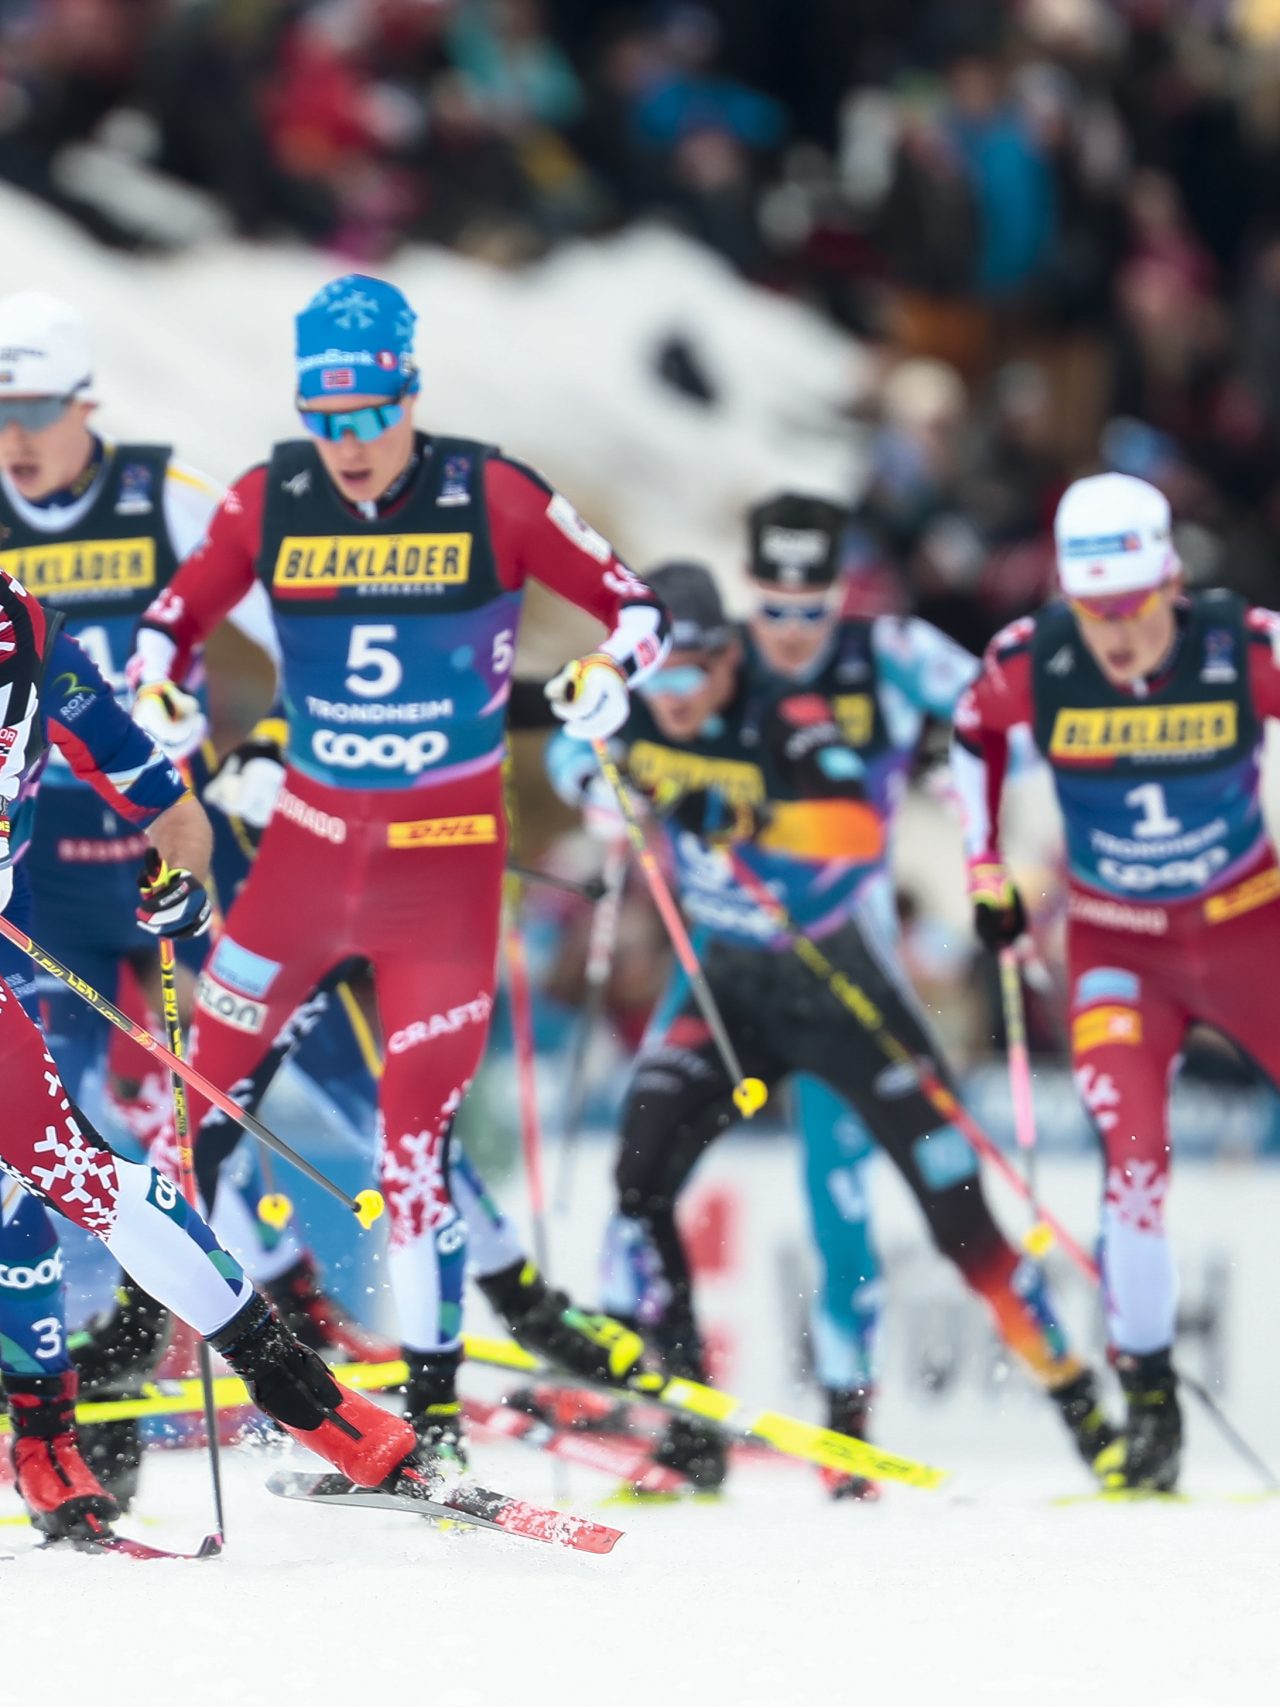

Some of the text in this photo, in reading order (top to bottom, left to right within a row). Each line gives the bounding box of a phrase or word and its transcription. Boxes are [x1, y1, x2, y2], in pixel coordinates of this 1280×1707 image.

[12, 548, 143, 586] ÅKLÄDER
[284, 535, 460, 578] BLÅKLÄDER
[345, 624, 403, 698] 5
[491, 629, 514, 674] 5
[59, 692, 86, 717] ROY
[305, 696, 454, 723] TRONDHEIM
[311, 728, 449, 774] coop
[1124, 782, 1182, 838] 1
[387, 996, 483, 1054] CRAFT
[31, 1317, 63, 1359] 3
